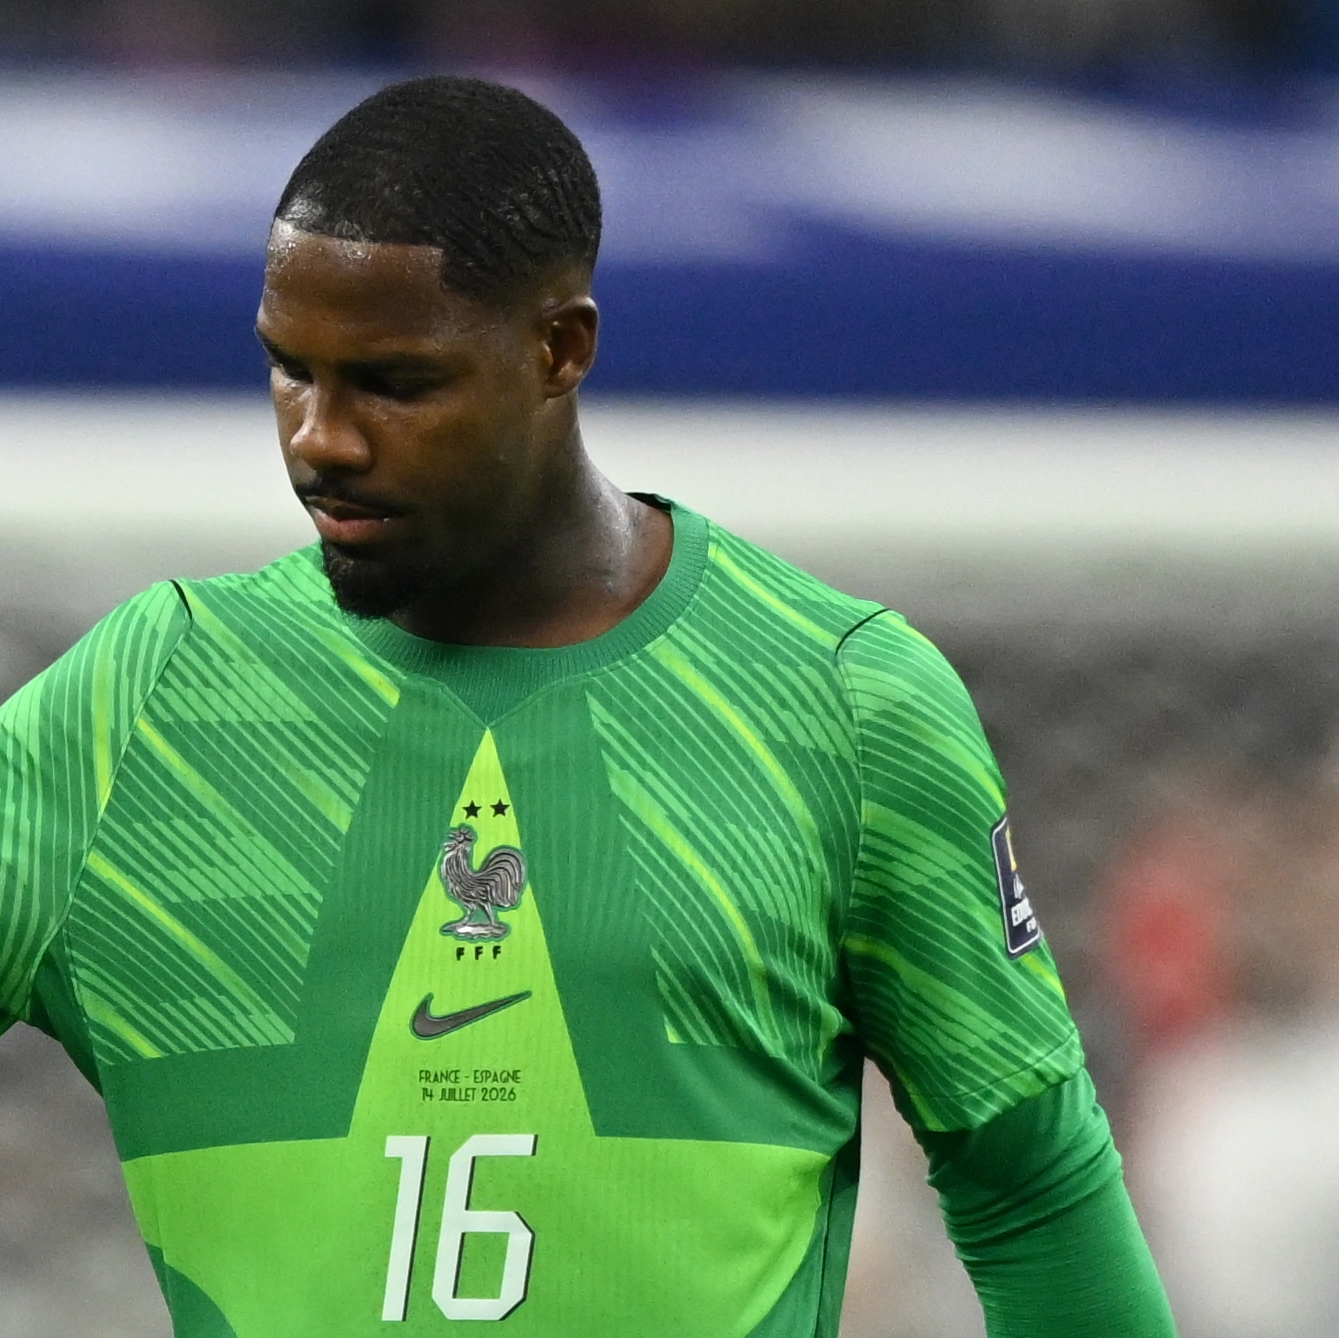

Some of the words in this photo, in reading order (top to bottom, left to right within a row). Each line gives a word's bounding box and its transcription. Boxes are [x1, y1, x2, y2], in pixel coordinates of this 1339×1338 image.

[419, 1069, 461, 1084] FRANCE
[473, 1069, 522, 1084] ESPAGNE
[422, 1087, 434, 1102] 14
[438, 1087, 477, 1102] JUILLET
[480, 1086, 517, 1102] 2026
[381, 1133, 539, 1322] 16
